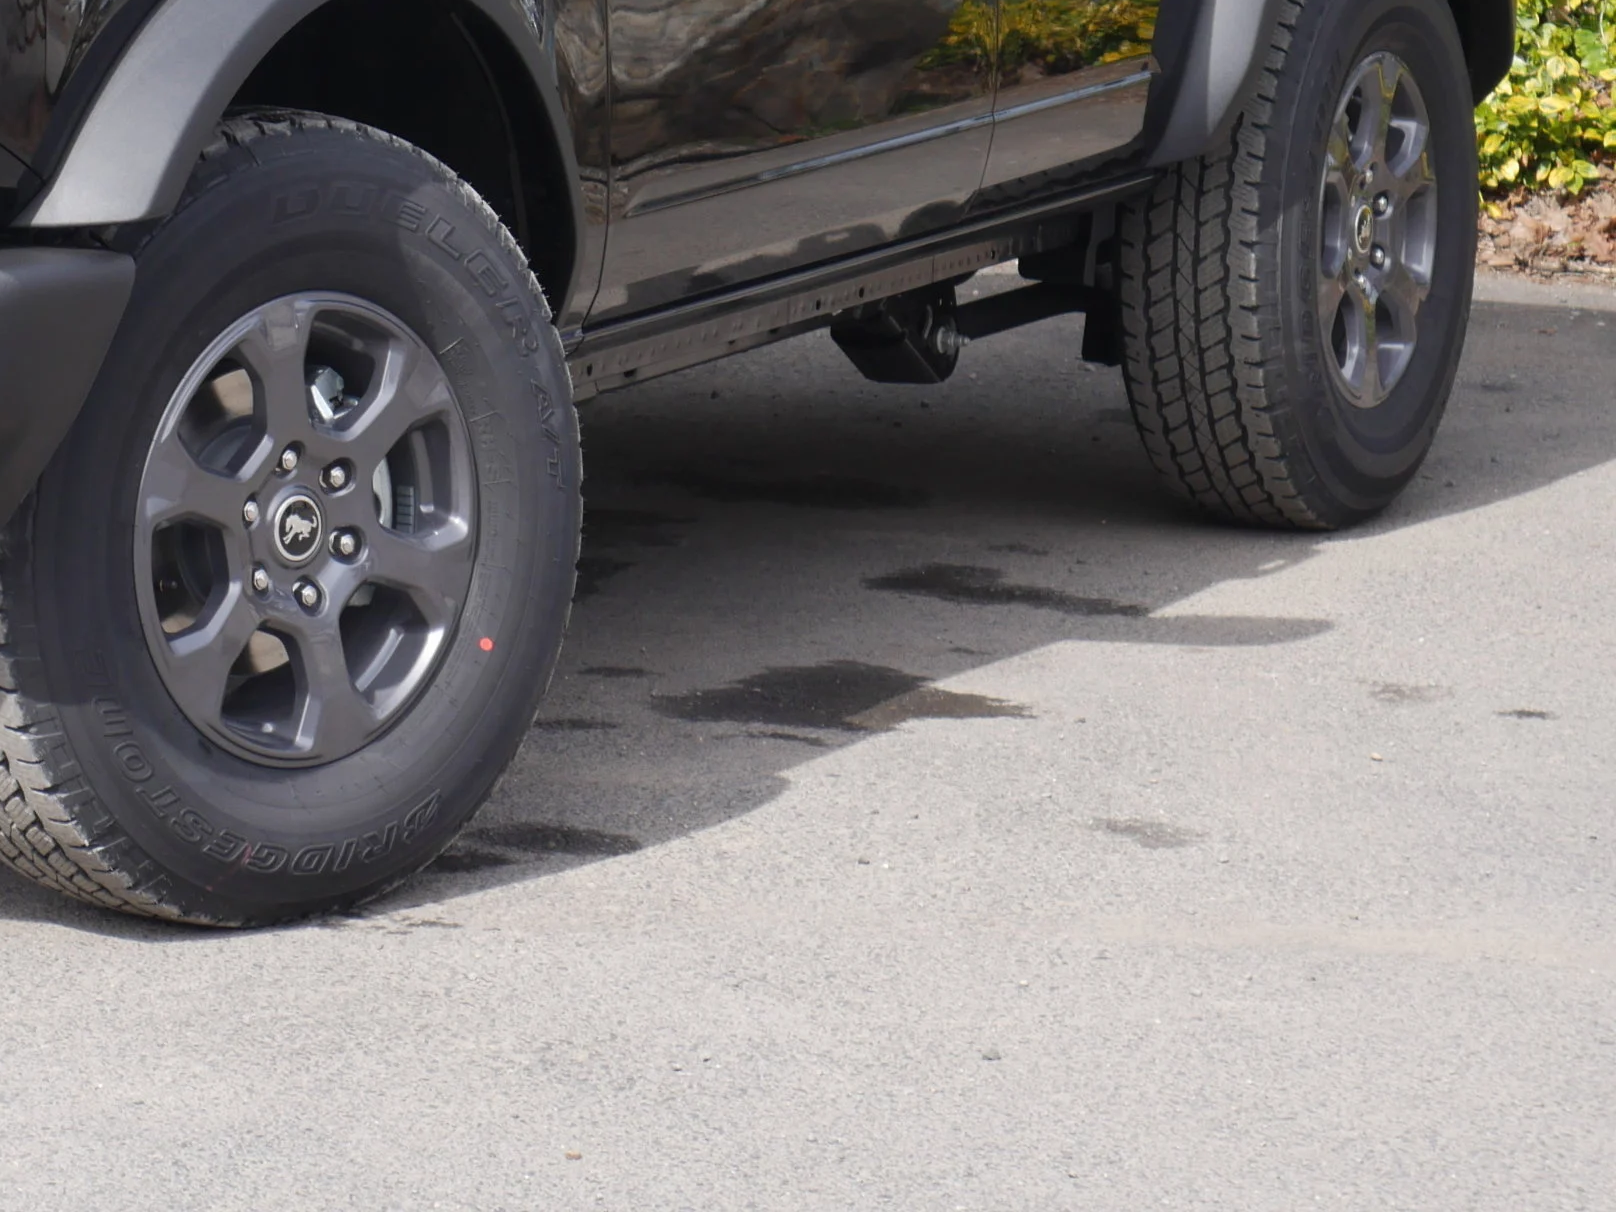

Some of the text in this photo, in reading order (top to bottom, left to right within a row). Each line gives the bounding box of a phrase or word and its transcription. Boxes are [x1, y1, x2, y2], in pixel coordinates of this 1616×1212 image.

[271, 183, 568, 492] DUELER A/T
[72, 648, 444, 877] BRIDGESTONE
